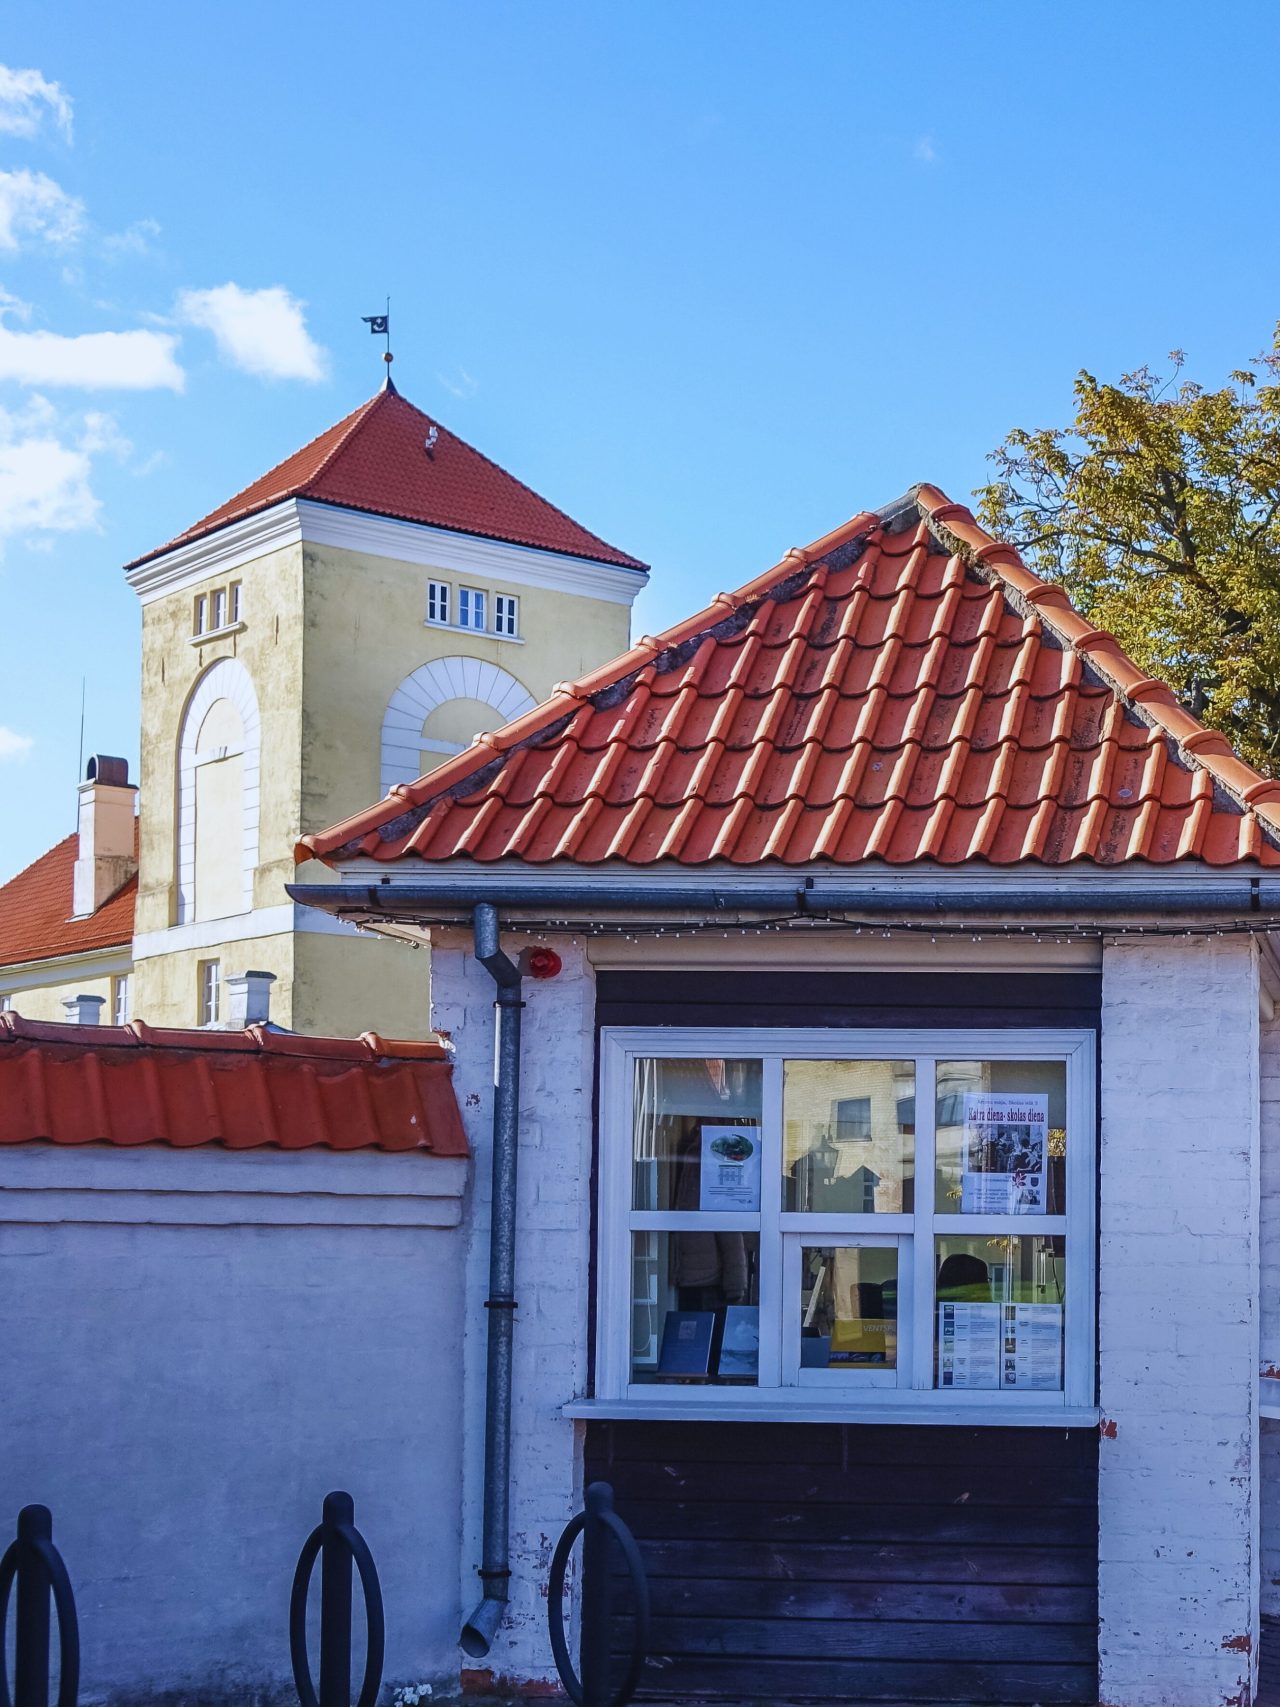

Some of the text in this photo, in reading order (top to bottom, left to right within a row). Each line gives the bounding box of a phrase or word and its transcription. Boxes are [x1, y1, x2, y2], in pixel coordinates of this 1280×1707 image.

[968, 1107, 985, 1121] Katra
[1007, 1107, 1026, 1122] skolas
[1028, 1108, 1044, 1122] diena
